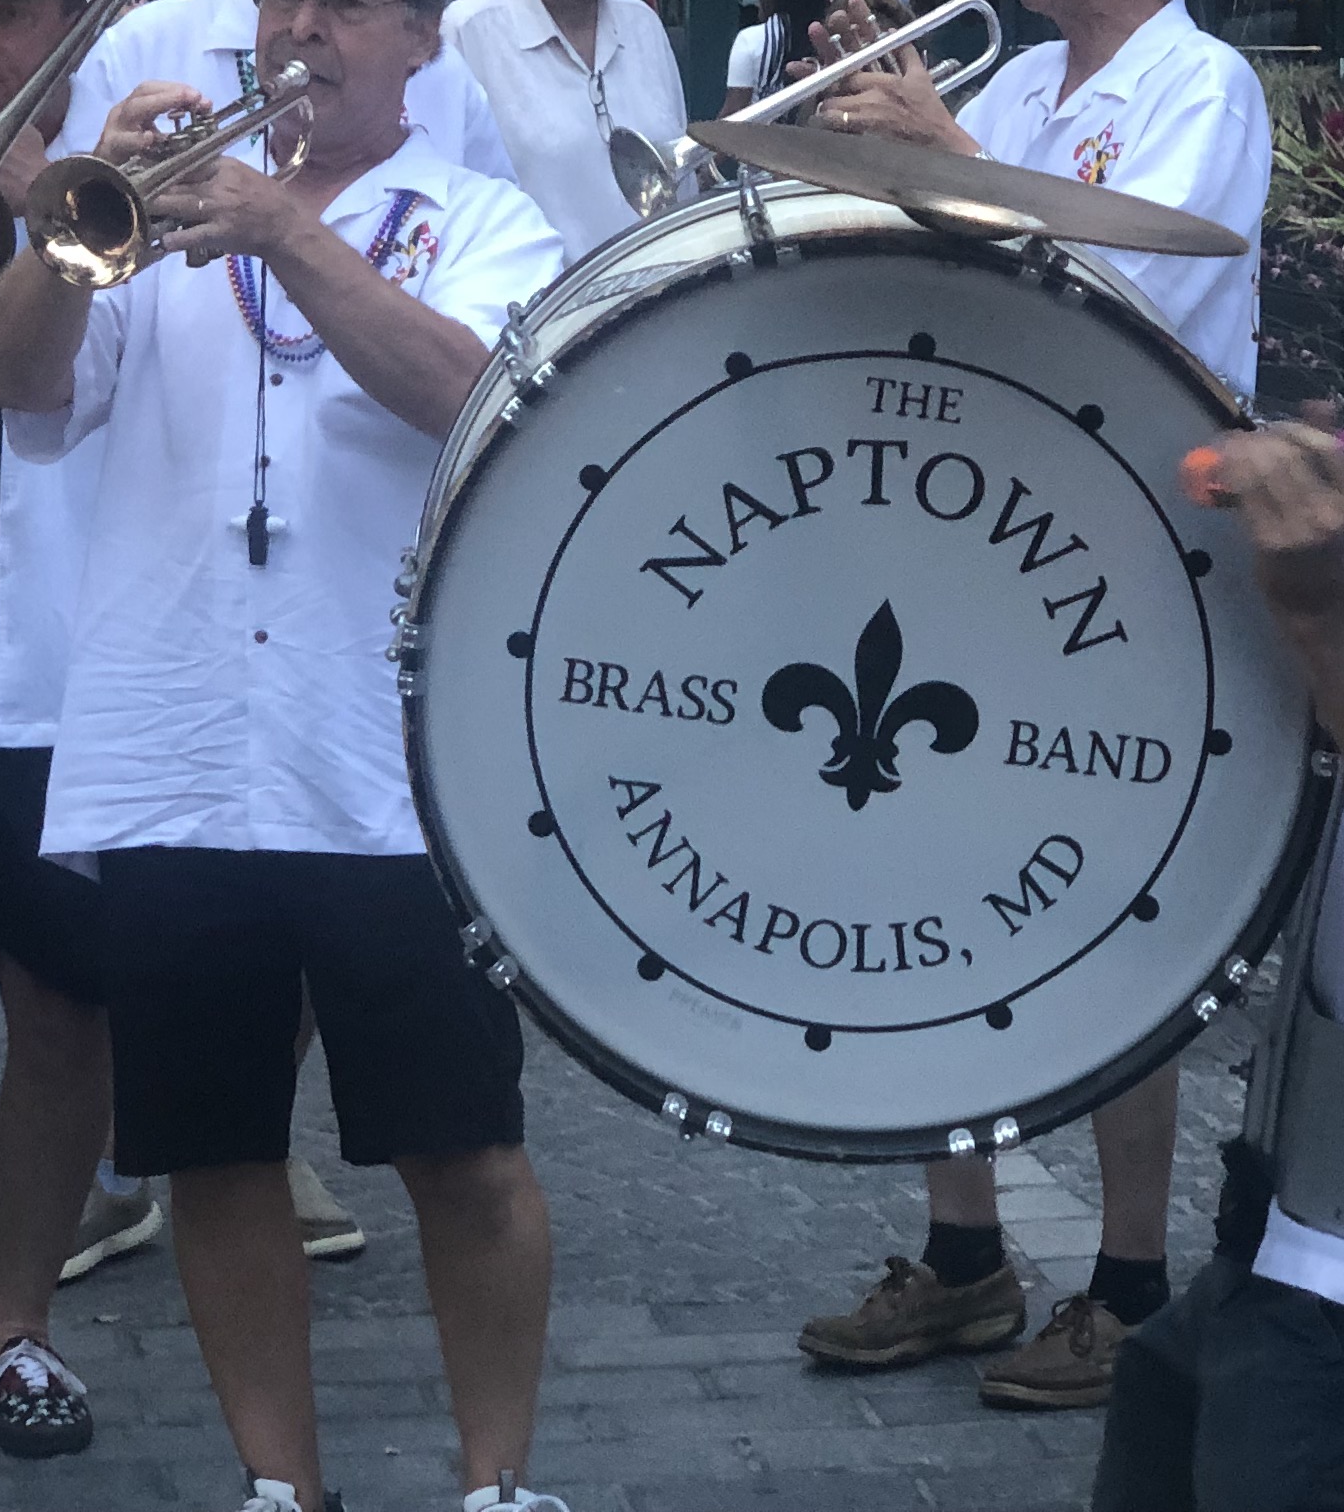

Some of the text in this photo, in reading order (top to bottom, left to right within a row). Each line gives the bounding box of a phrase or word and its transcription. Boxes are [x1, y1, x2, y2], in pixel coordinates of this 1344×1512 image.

[866, 376, 964, 426] THE
[638, 438, 1130, 657] NAPTOWN
[558, 657, 1173, 786] BRASS BAND
[607, 774, 1086, 975] ANNAPOLIS, MD
